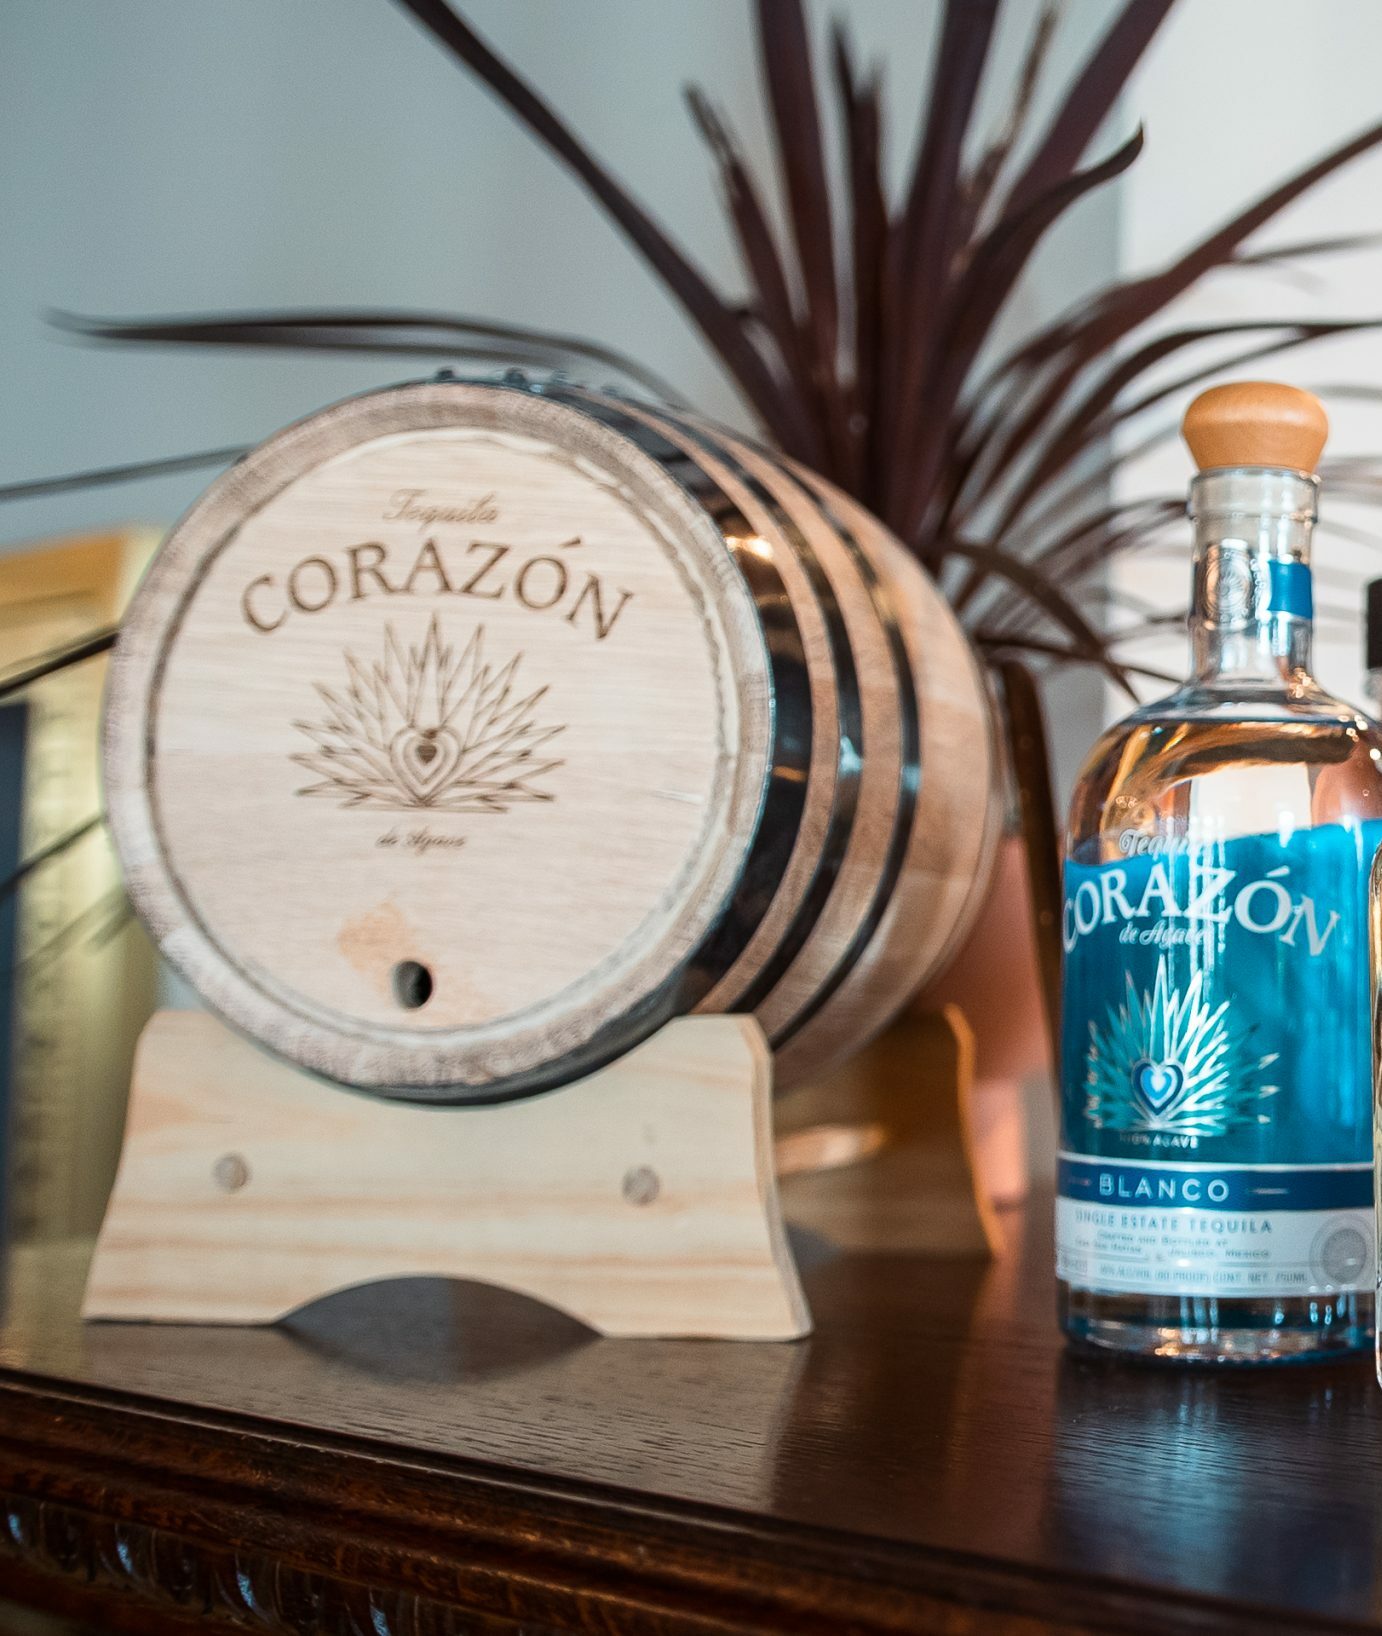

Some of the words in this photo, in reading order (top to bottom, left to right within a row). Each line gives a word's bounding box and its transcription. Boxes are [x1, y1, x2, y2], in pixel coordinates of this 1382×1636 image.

[381, 487, 500, 534] Tequila
[240, 536, 635, 642] CORAZÓN
[1062, 861, 1341, 957] CORAZÓN
[1119, 921, 1139, 945] de
[1098, 1172, 1230, 1202] BLANCO
[1121, 1213, 1179, 1232] ESTATE
[1188, 1217, 1273, 1234] TEQUILA
